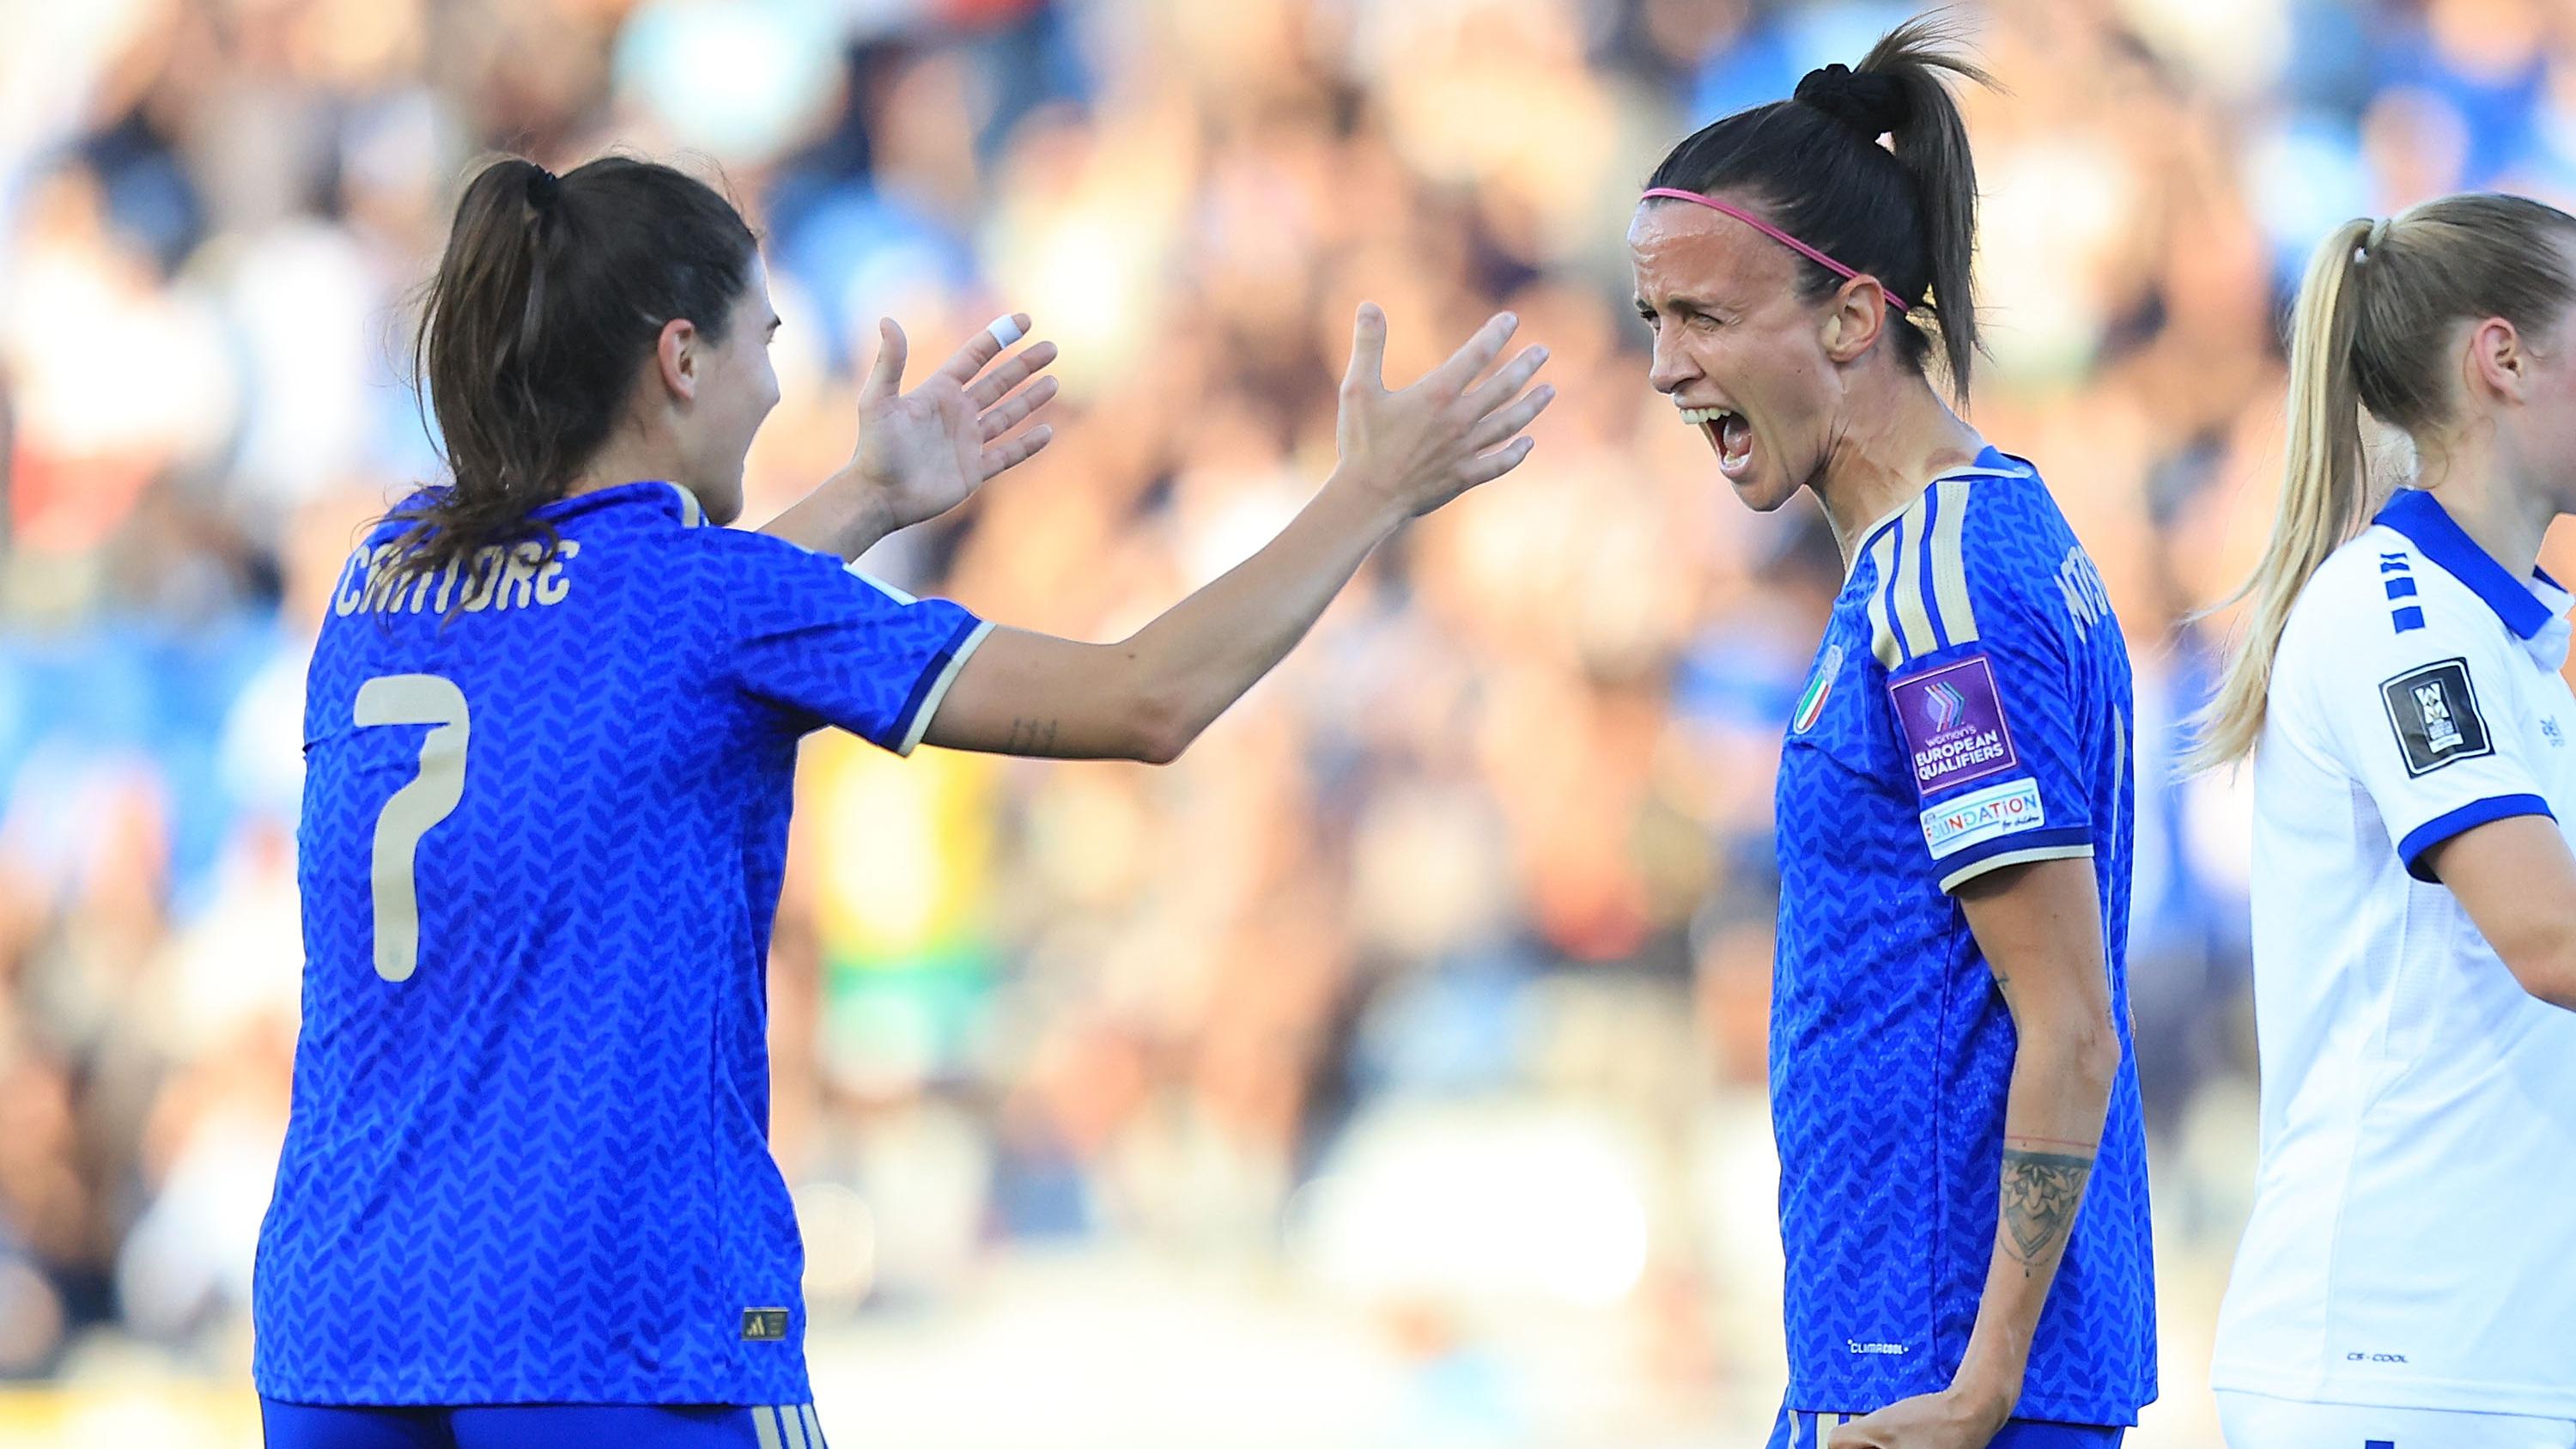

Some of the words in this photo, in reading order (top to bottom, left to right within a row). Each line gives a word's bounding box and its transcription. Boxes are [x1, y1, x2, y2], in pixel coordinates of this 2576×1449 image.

[1915, 729, 1998, 767] EUROPEAN
[1918, 742, 2004, 781] QUALIFIERS
[353, 673, 471, 983] 7
